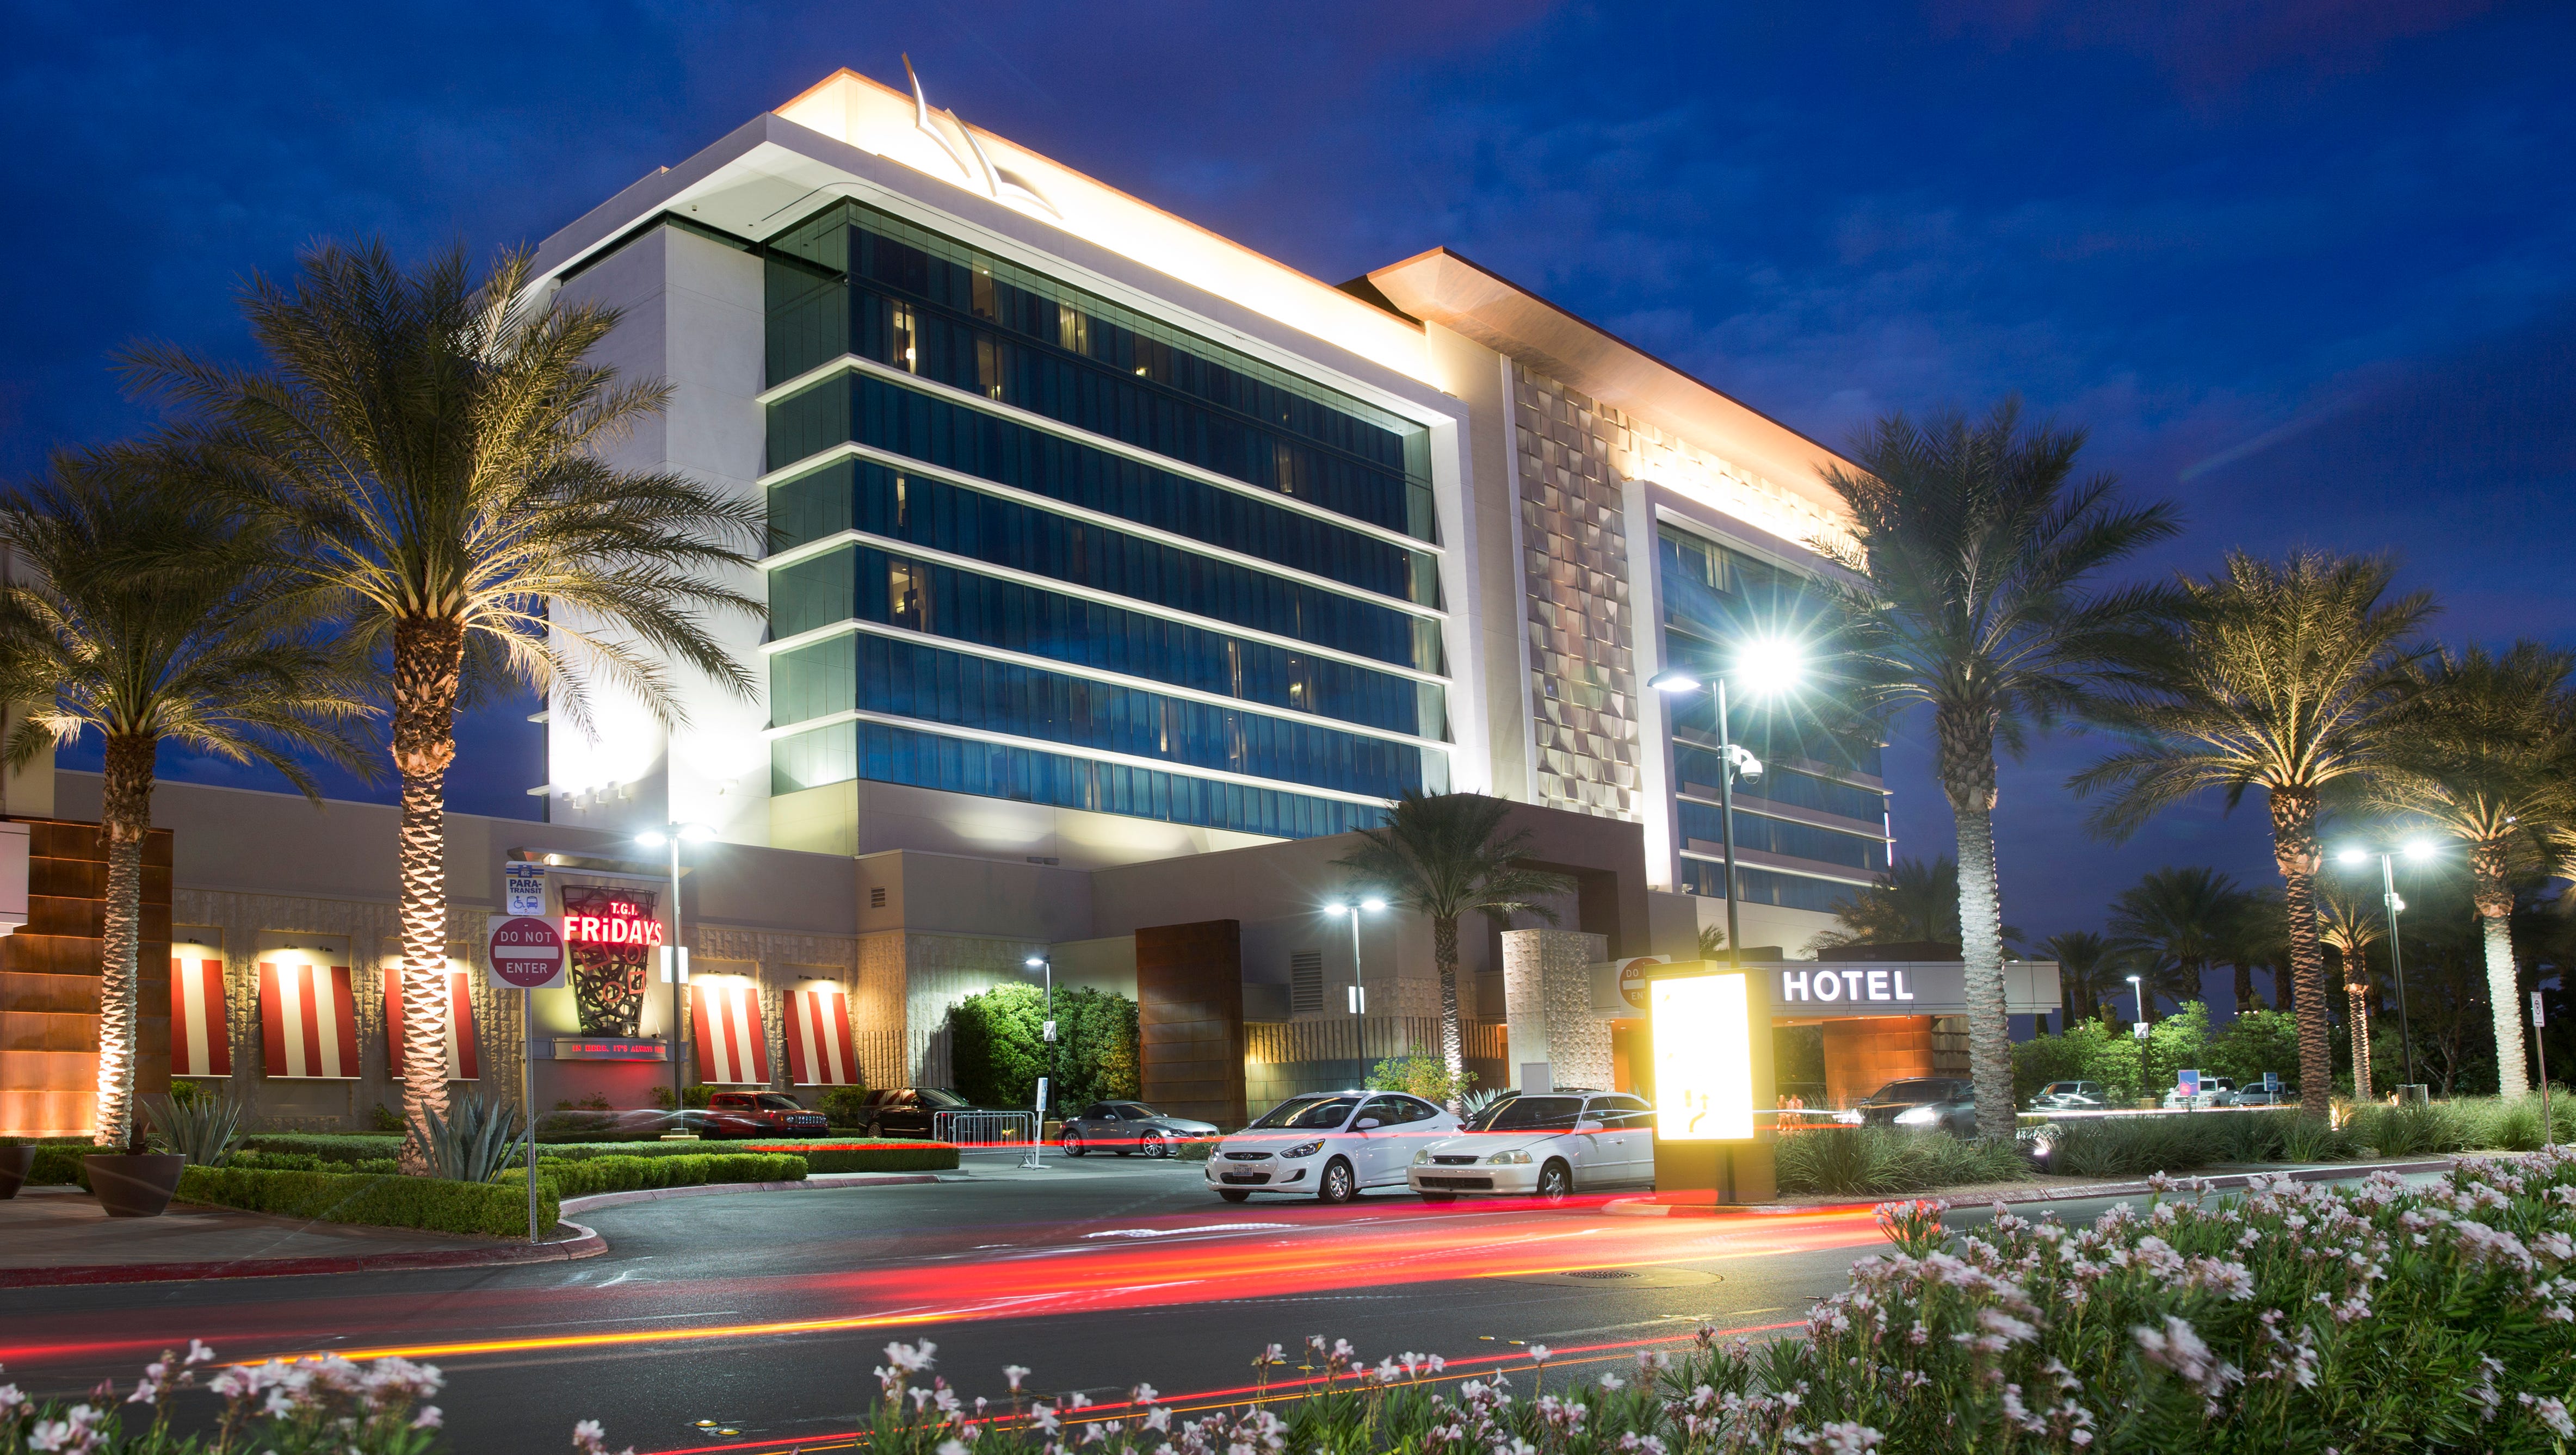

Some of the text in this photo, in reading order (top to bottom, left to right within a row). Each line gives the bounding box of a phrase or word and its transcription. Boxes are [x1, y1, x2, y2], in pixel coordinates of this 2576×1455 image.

[510, 879, 542, 887] PARA-
[610, 902, 638, 915] T.G.I.
[501, 931, 552, 943] DO NOT
[506, 963, 547, 974] ENTER
[1626, 969, 1639, 977] DO
[1783, 970, 1913, 1001] HOTEL
[1050, 1031, 1054, 1039] 1
